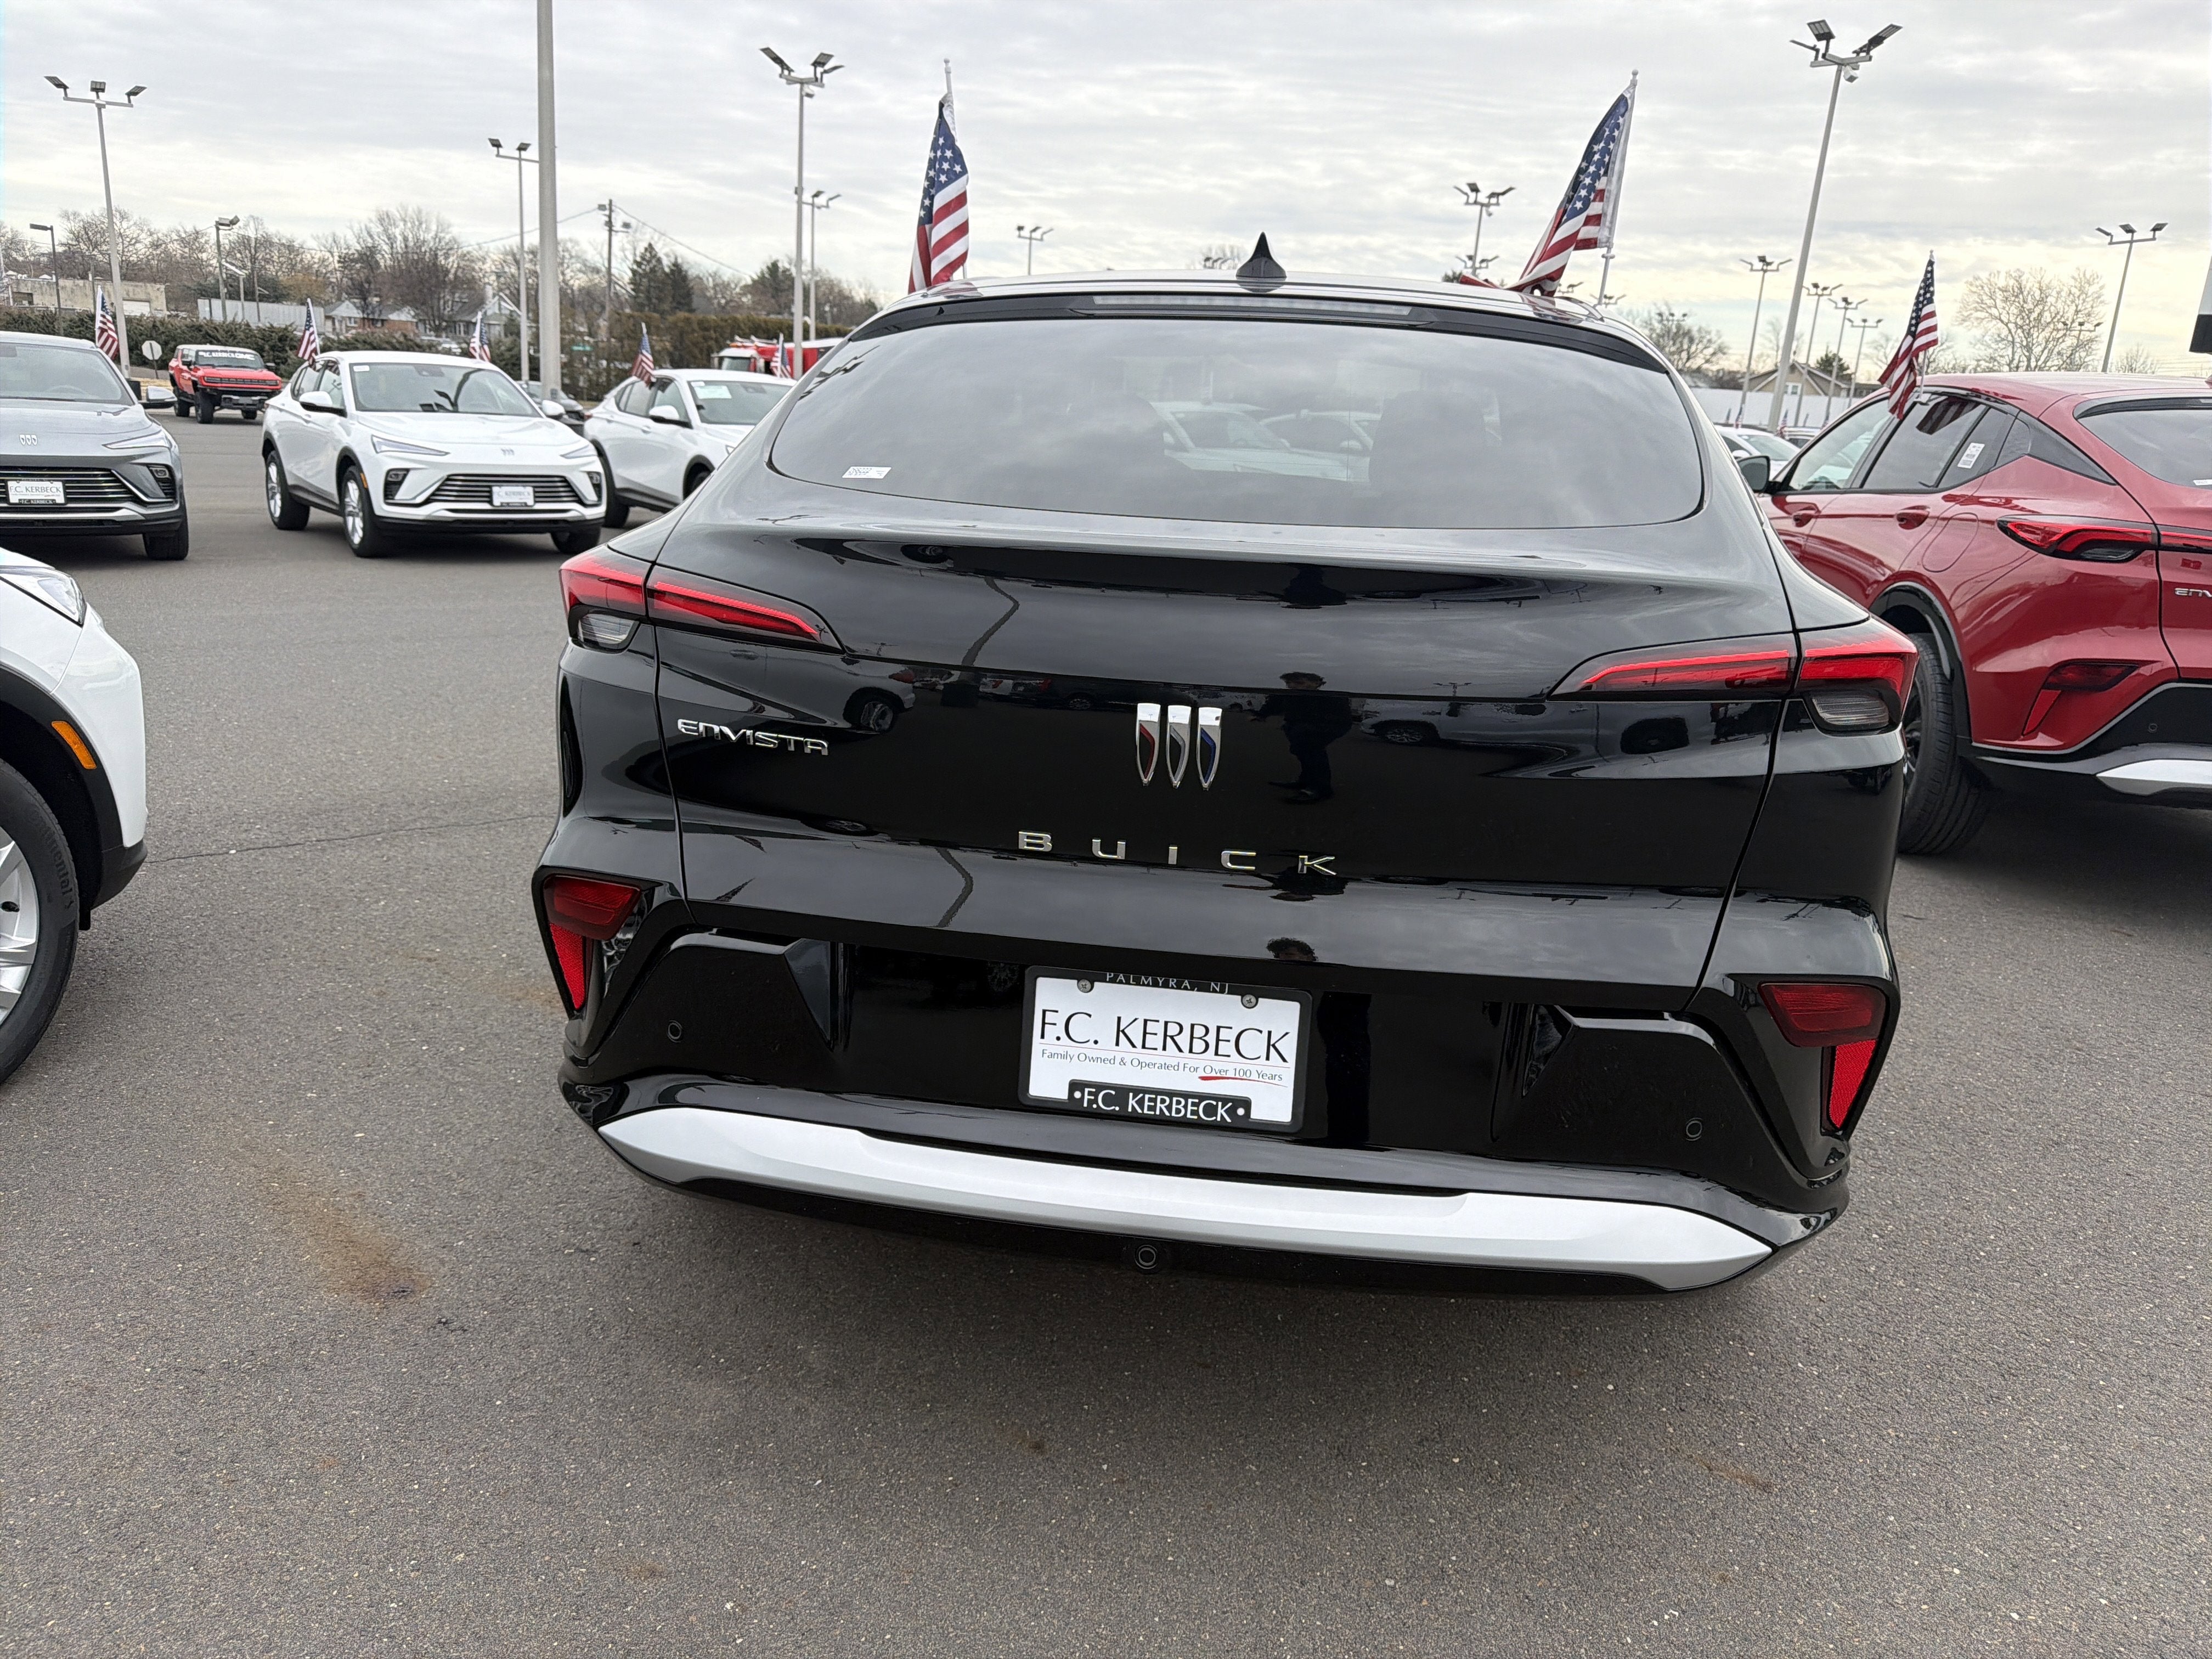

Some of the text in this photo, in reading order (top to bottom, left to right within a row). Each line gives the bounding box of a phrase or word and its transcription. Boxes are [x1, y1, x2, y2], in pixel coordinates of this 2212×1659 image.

[678, 719, 828, 756] ENVISTA
[1018, 830, 1337, 876] BUICK
[1106, 972, 1229, 994] PALMYRA, NJ
[1040, 1008, 1291, 1063] F.C. KERBECK
[1041, 1048, 1283, 1082] Family Owned & Operated For Over 100 Years
[1083, 1087, 1233, 1123] F.C. KERBECK
